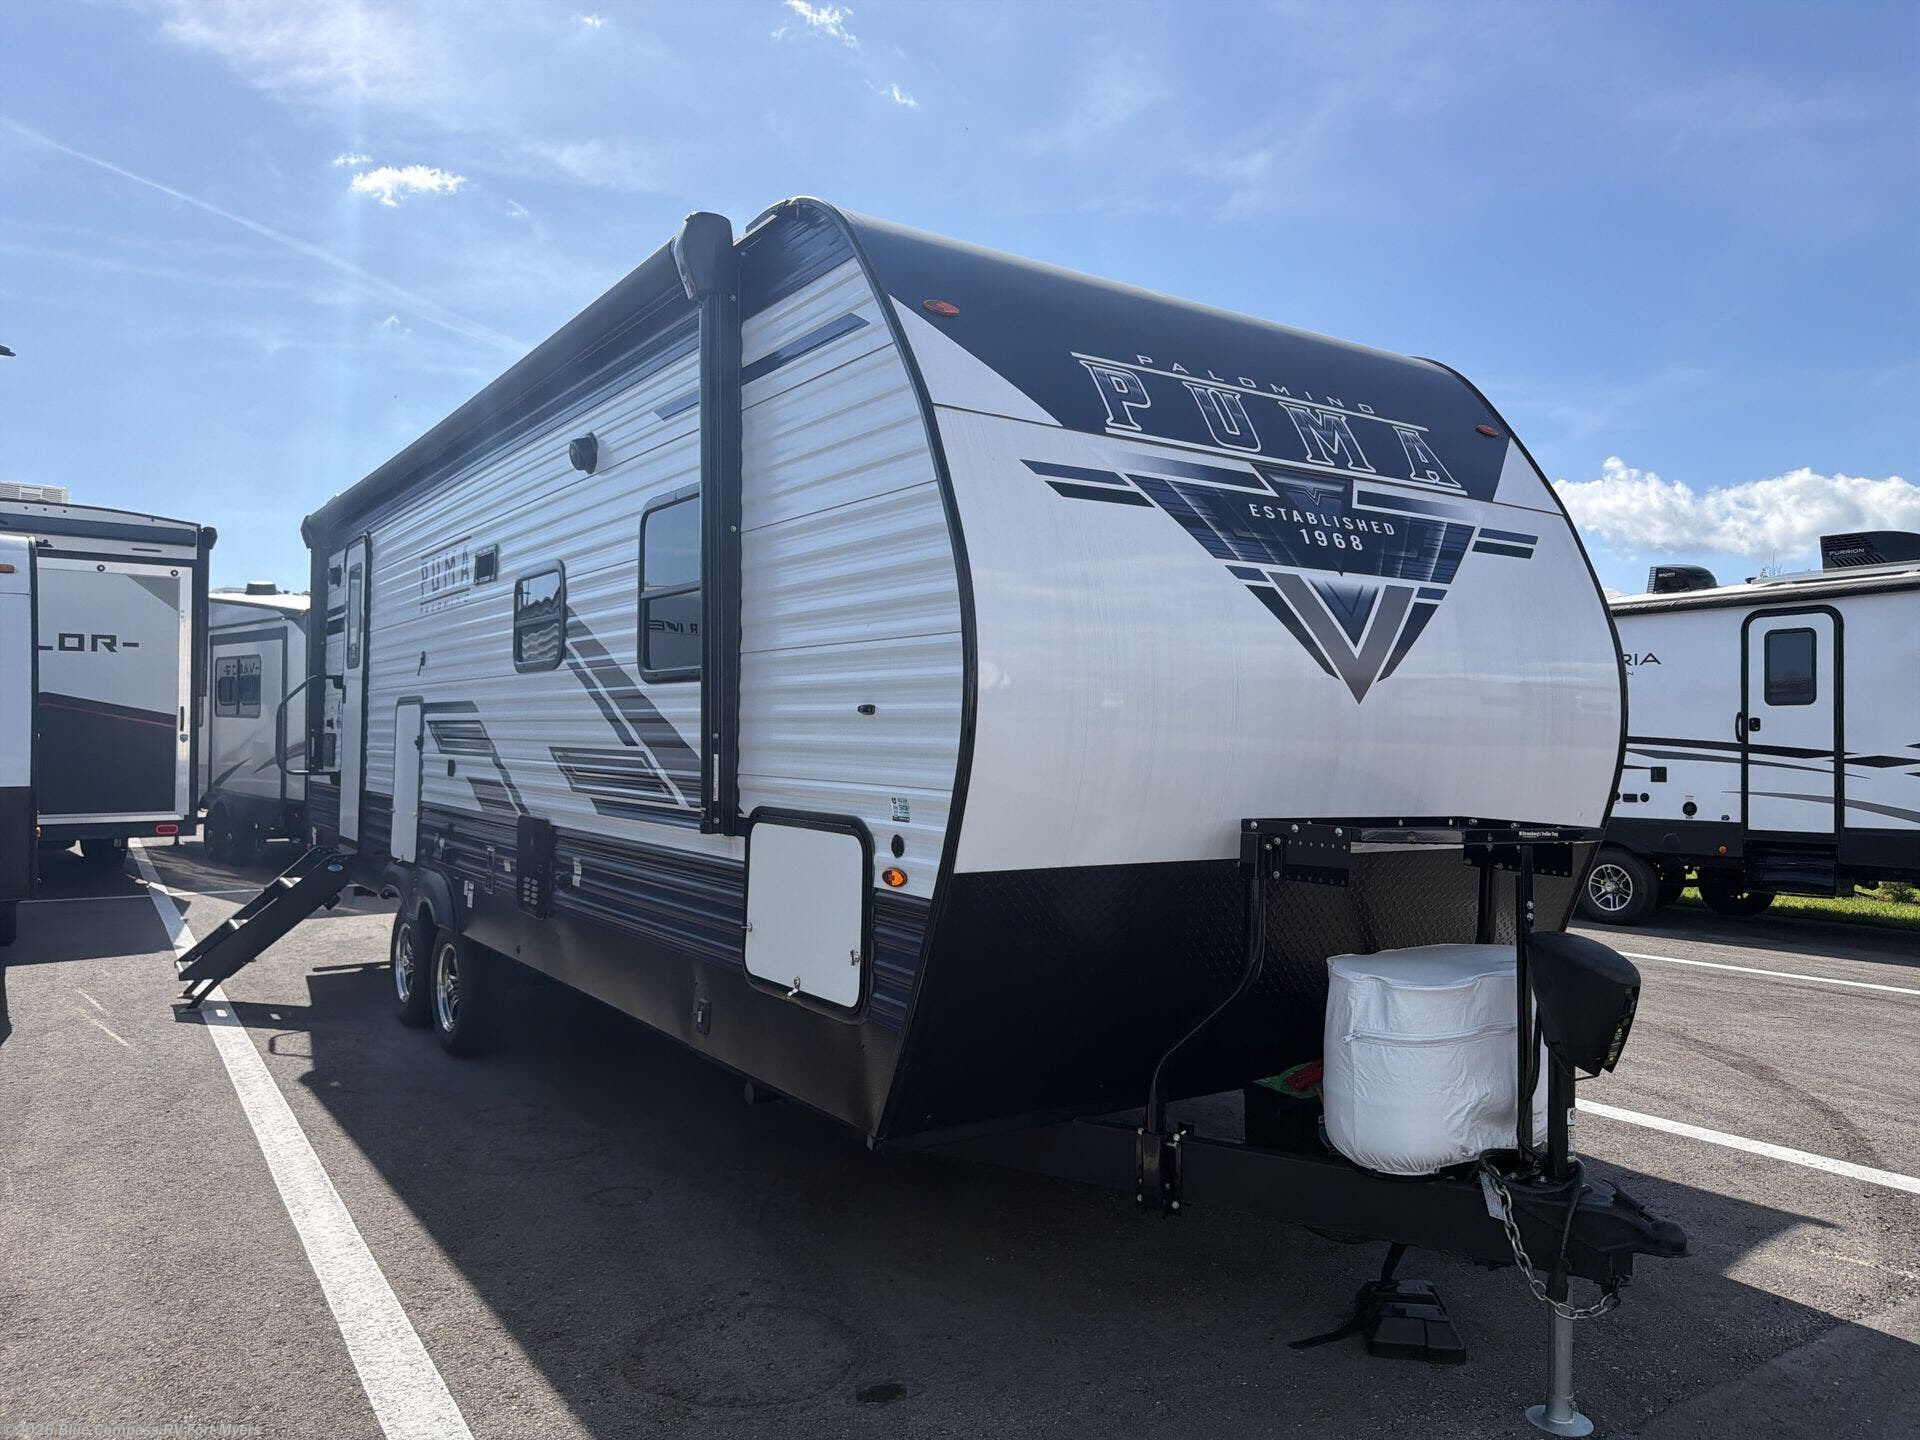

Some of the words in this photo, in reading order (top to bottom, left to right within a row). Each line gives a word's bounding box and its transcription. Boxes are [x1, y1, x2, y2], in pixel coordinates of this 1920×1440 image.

[1136, 354, 1375, 415] PALOMINO
[1079, 359, 1462, 488] PUMA
[1248, 503, 1396, 536] ESTABLISHED
[1300, 528, 1364, 551] 1968
[1828, 547, 1865, 557] FURRION
